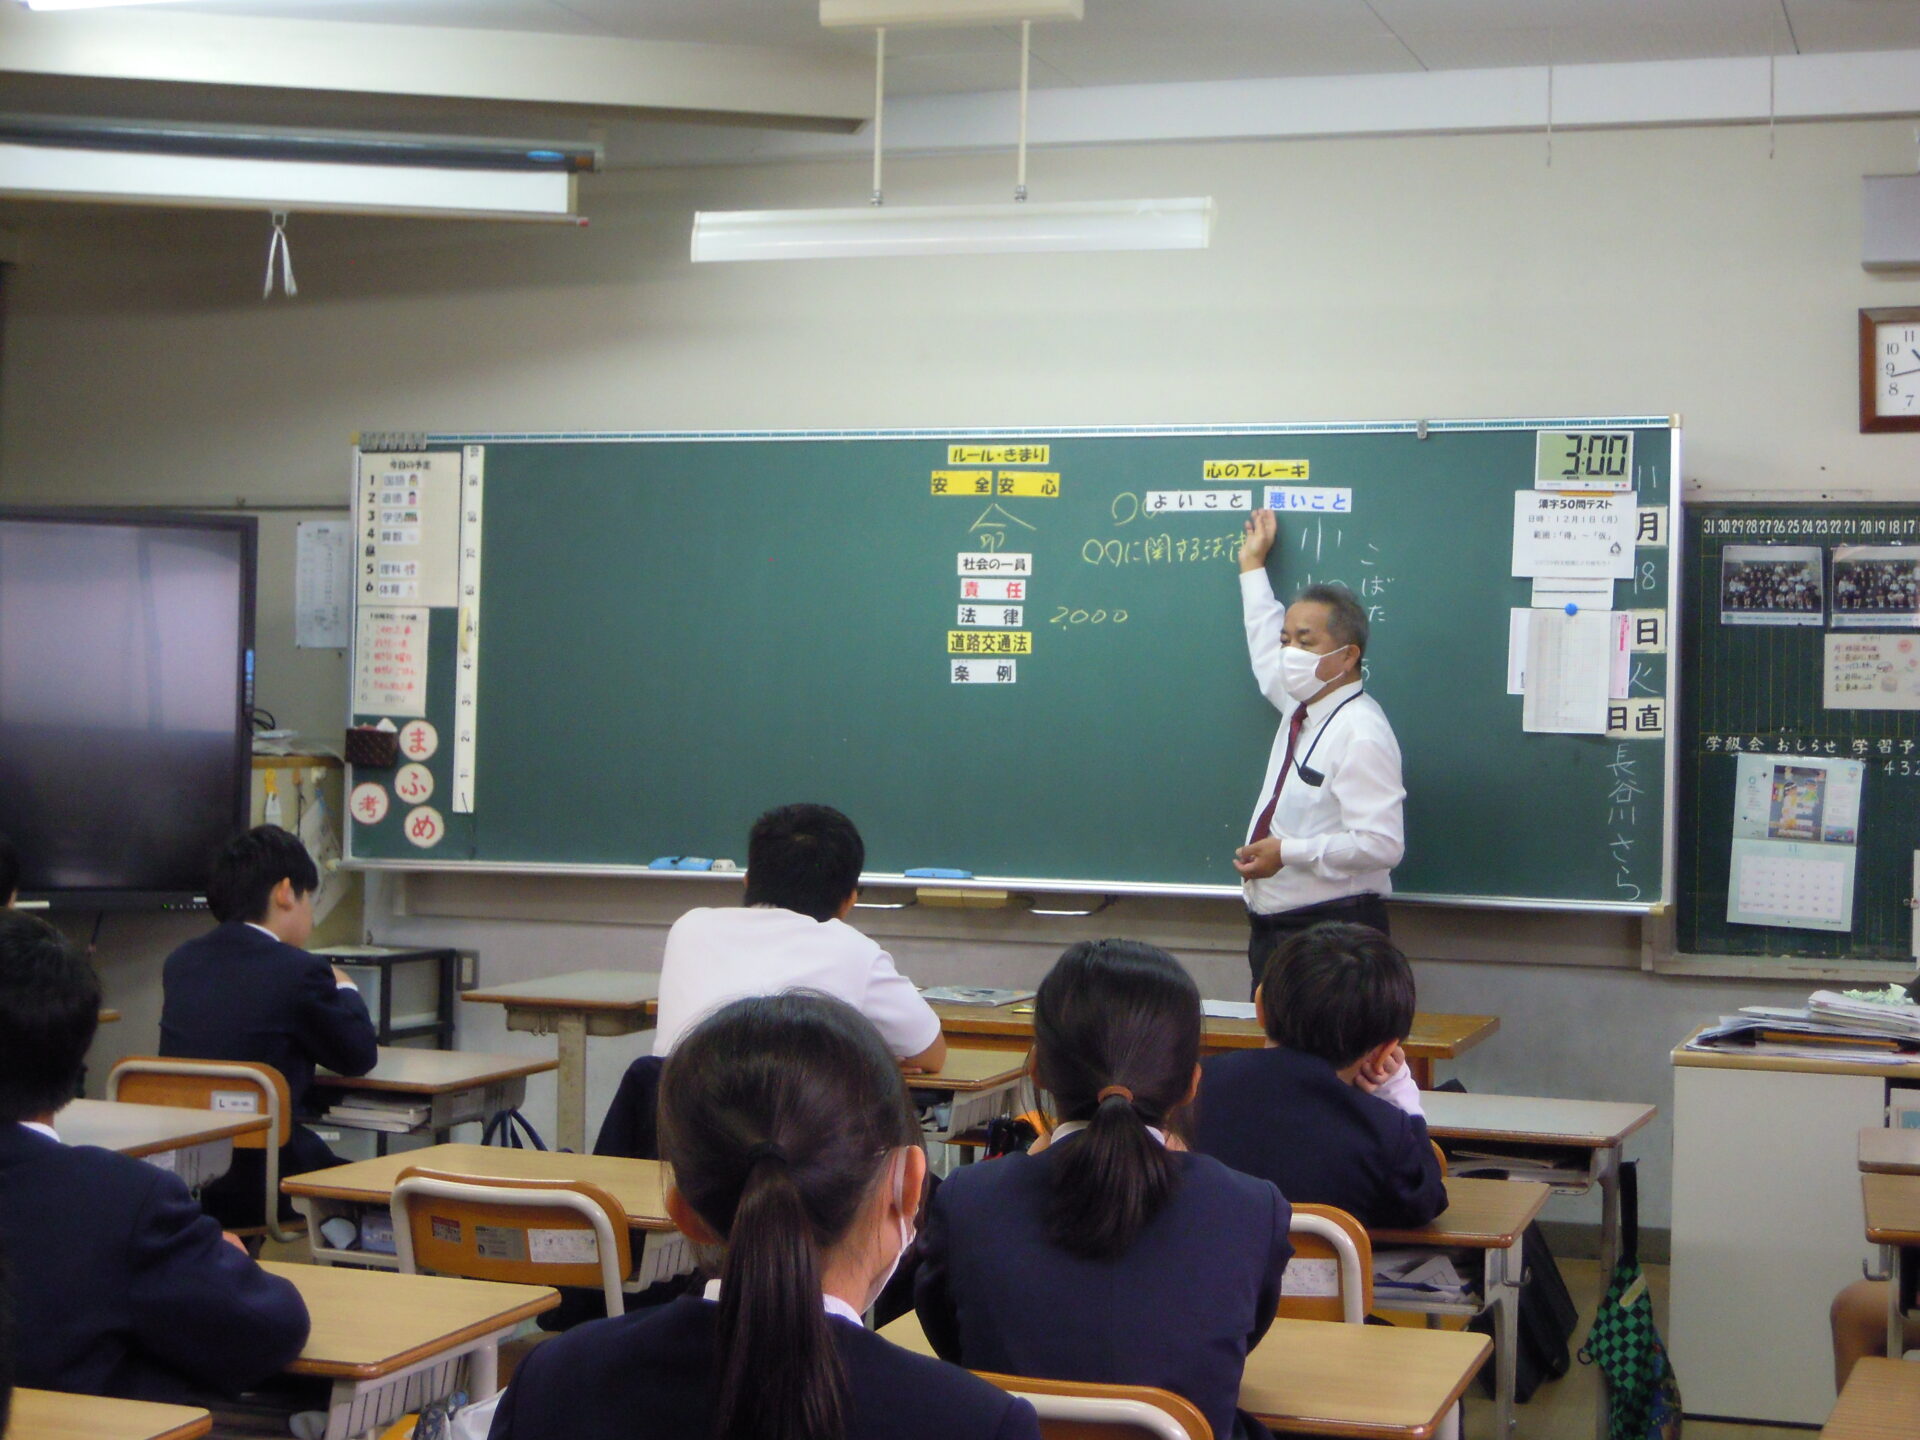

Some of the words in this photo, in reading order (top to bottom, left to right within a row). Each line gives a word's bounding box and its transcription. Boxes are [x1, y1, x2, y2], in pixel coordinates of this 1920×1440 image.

[1904, 330, 1915, 342] 11
[1886, 343, 1899, 355] 10
[1886, 362, 1895, 376] 9
[1889, 383, 1898, 395] 8
[1905, 394, 1914, 407] 7
[953, 448, 1045, 462] ルール・きまり
[1562, 435, 1628, 475] 3:00
[1206, 463, 1306, 478] 心のブレーキ
[370, 474, 375, 486] 1
[368, 492, 375, 504] 2
[1154, 493, 1243, 509] よいこと
[1269, 491, 1346, 510] 悪いこと
[1539, 499, 1612, 510] 漢字50問テスト
[368, 510, 375, 522] 3
[367, 528, 375, 539] 4
[1637, 512, 1658, 541] 月
[1704, 519, 1715, 534] 31
[1718, 519, 1730, 534] 30
[1732, 519, 1744, 534] 29
[1746, 519, 1758, 534] 28
[1759, 519, 1772, 534] 27
[1773, 519, 1785, 534] 26
[1787, 519, 1800, 534] 25
[1802, 519, 1813, 534] 24
[1816, 519, 1828, 534] 23
[1830, 519, 1841, 534] 22
[1844, 519, 1856, 534] 21
[1860, 519, 1872, 534] 20
[1875, 519, 1886, 534] 19
[1889, 519, 1900, 534] 18
[1903, 519, 1915, 534] 17
[366, 563, 374, 575] 5
[963, 558, 1026, 571] 社会の一員
[366, 581, 374, 593] 6
[964, 582, 1022, 598] 責任
[961, 608, 1019, 625] 法律
[1637, 618, 1658, 645] 日
[951, 635, 1028, 652] 道路交通法
[954, 665, 1012, 682] 条例
[1608, 704, 1662, 732] 日直
[409, 728, 427, 753] ま
[1705, 735, 1765, 751] 学級会
[1777, 737, 1836, 753] おしらせ
[1900, 760, 1910, 776] 3
[402, 772, 427, 796] ふ
[412, 815, 436, 839] め
